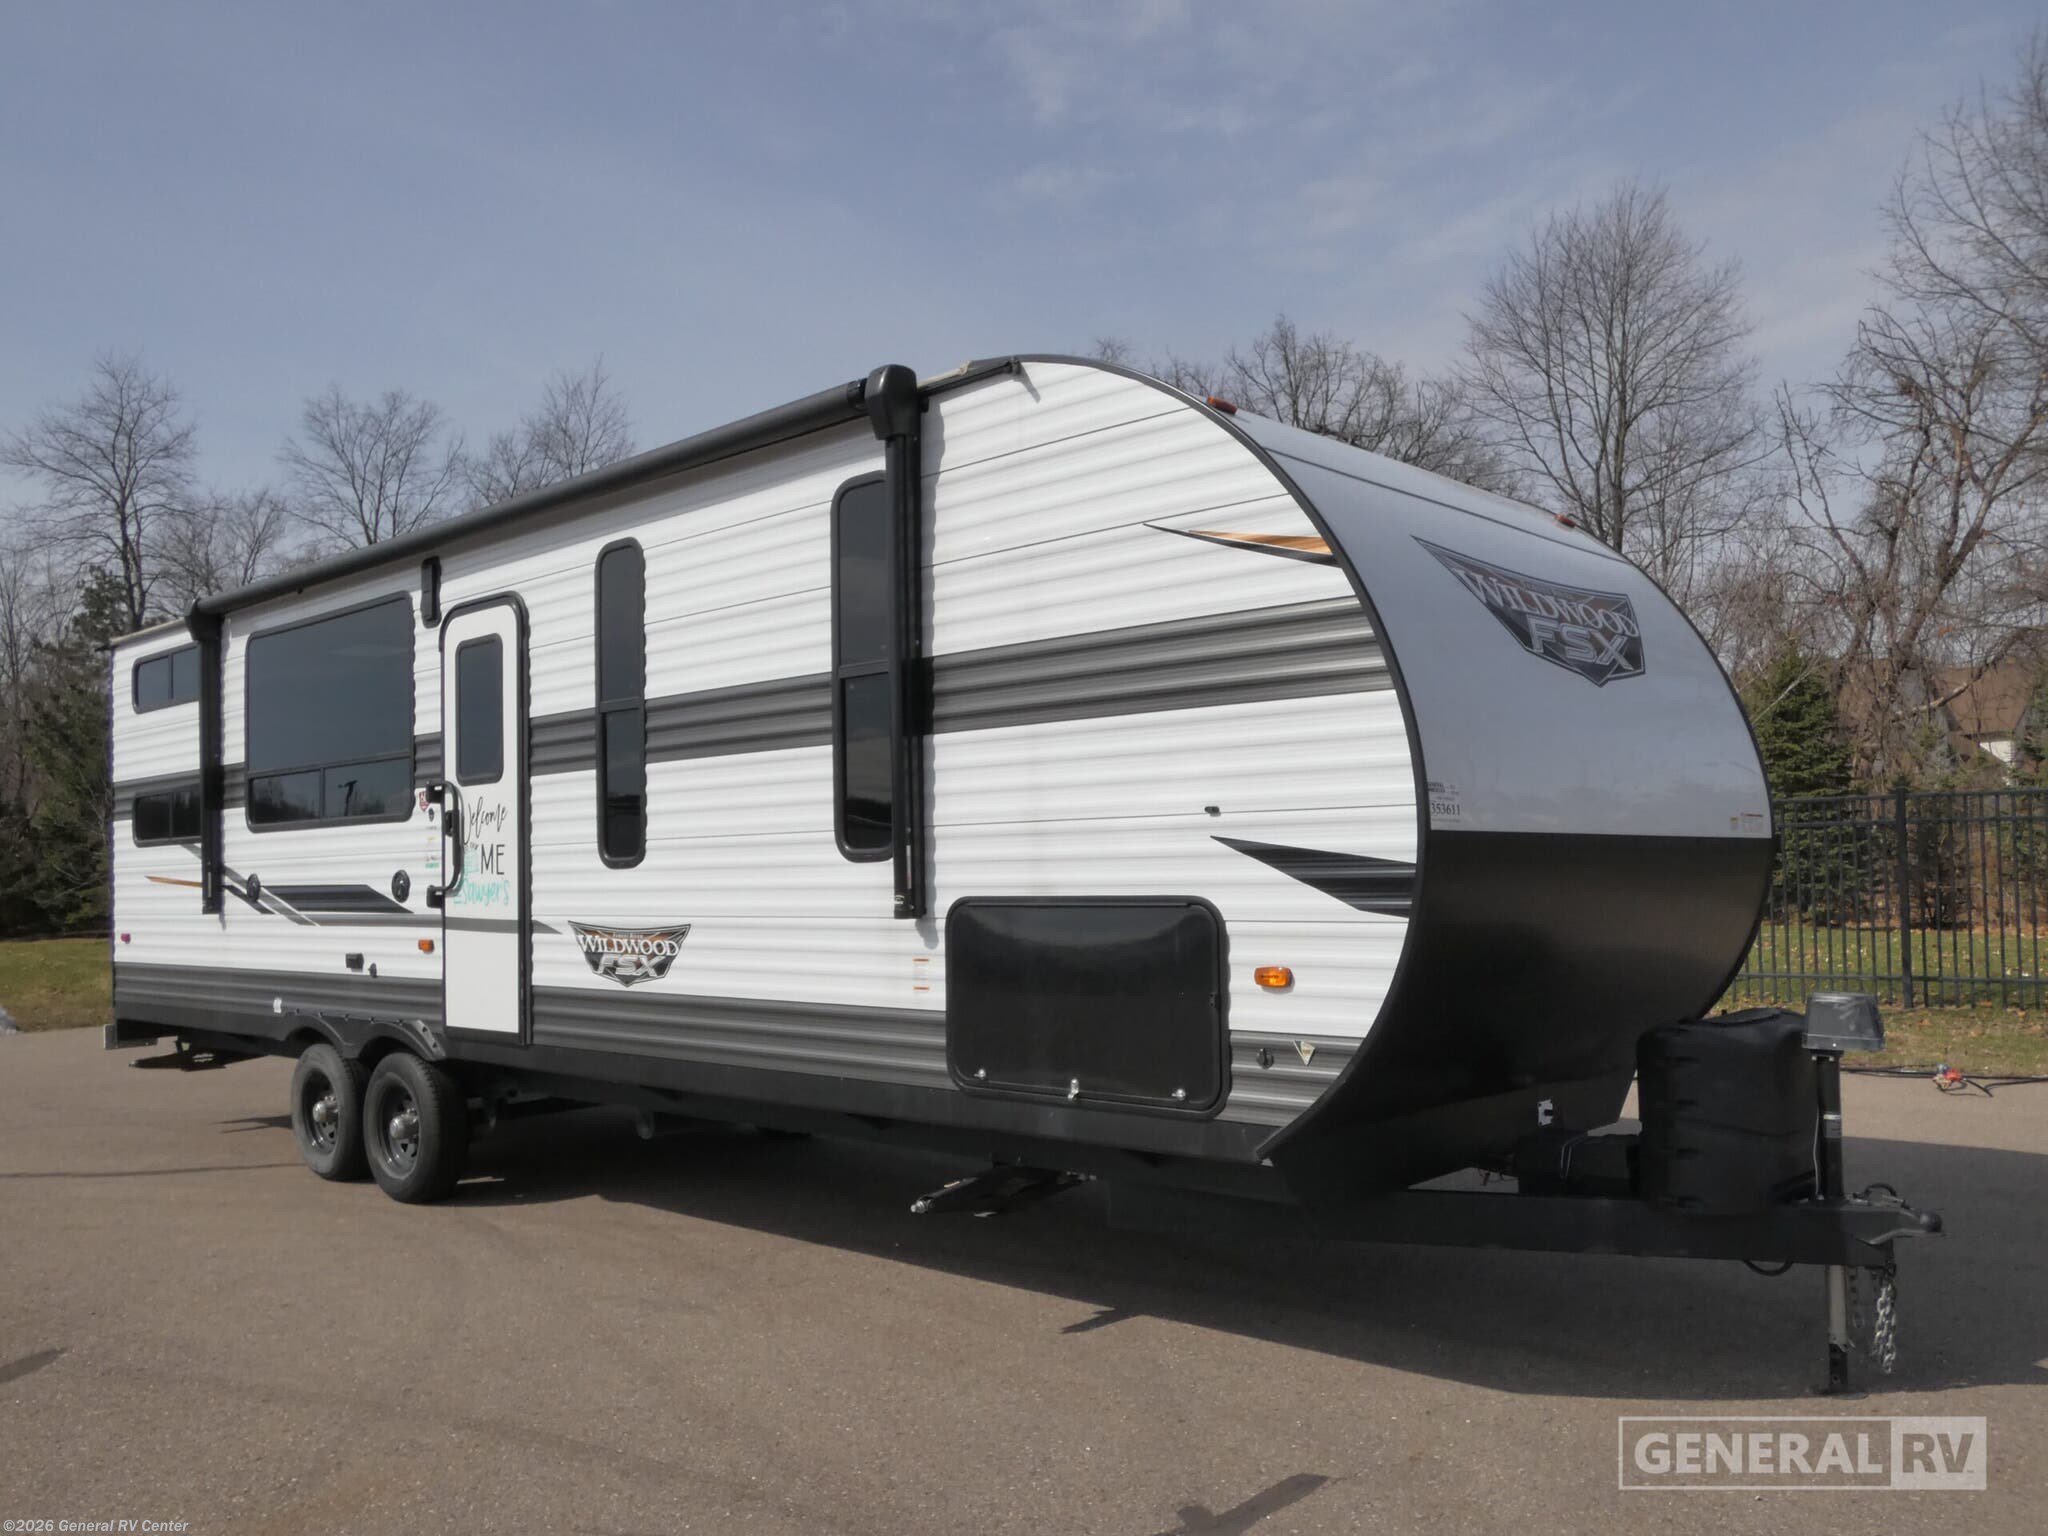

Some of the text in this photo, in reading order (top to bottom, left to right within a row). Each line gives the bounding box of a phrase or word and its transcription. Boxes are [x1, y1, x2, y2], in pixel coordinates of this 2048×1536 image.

[1451, 568, 1640, 637] WILDWOOD
[1526, 614, 1635, 671] FSX
[1430, 802, 1461, 817] 353611
[577, 934, 680, 957] WILDWOOD
[597, 953, 667, 977] FSX
